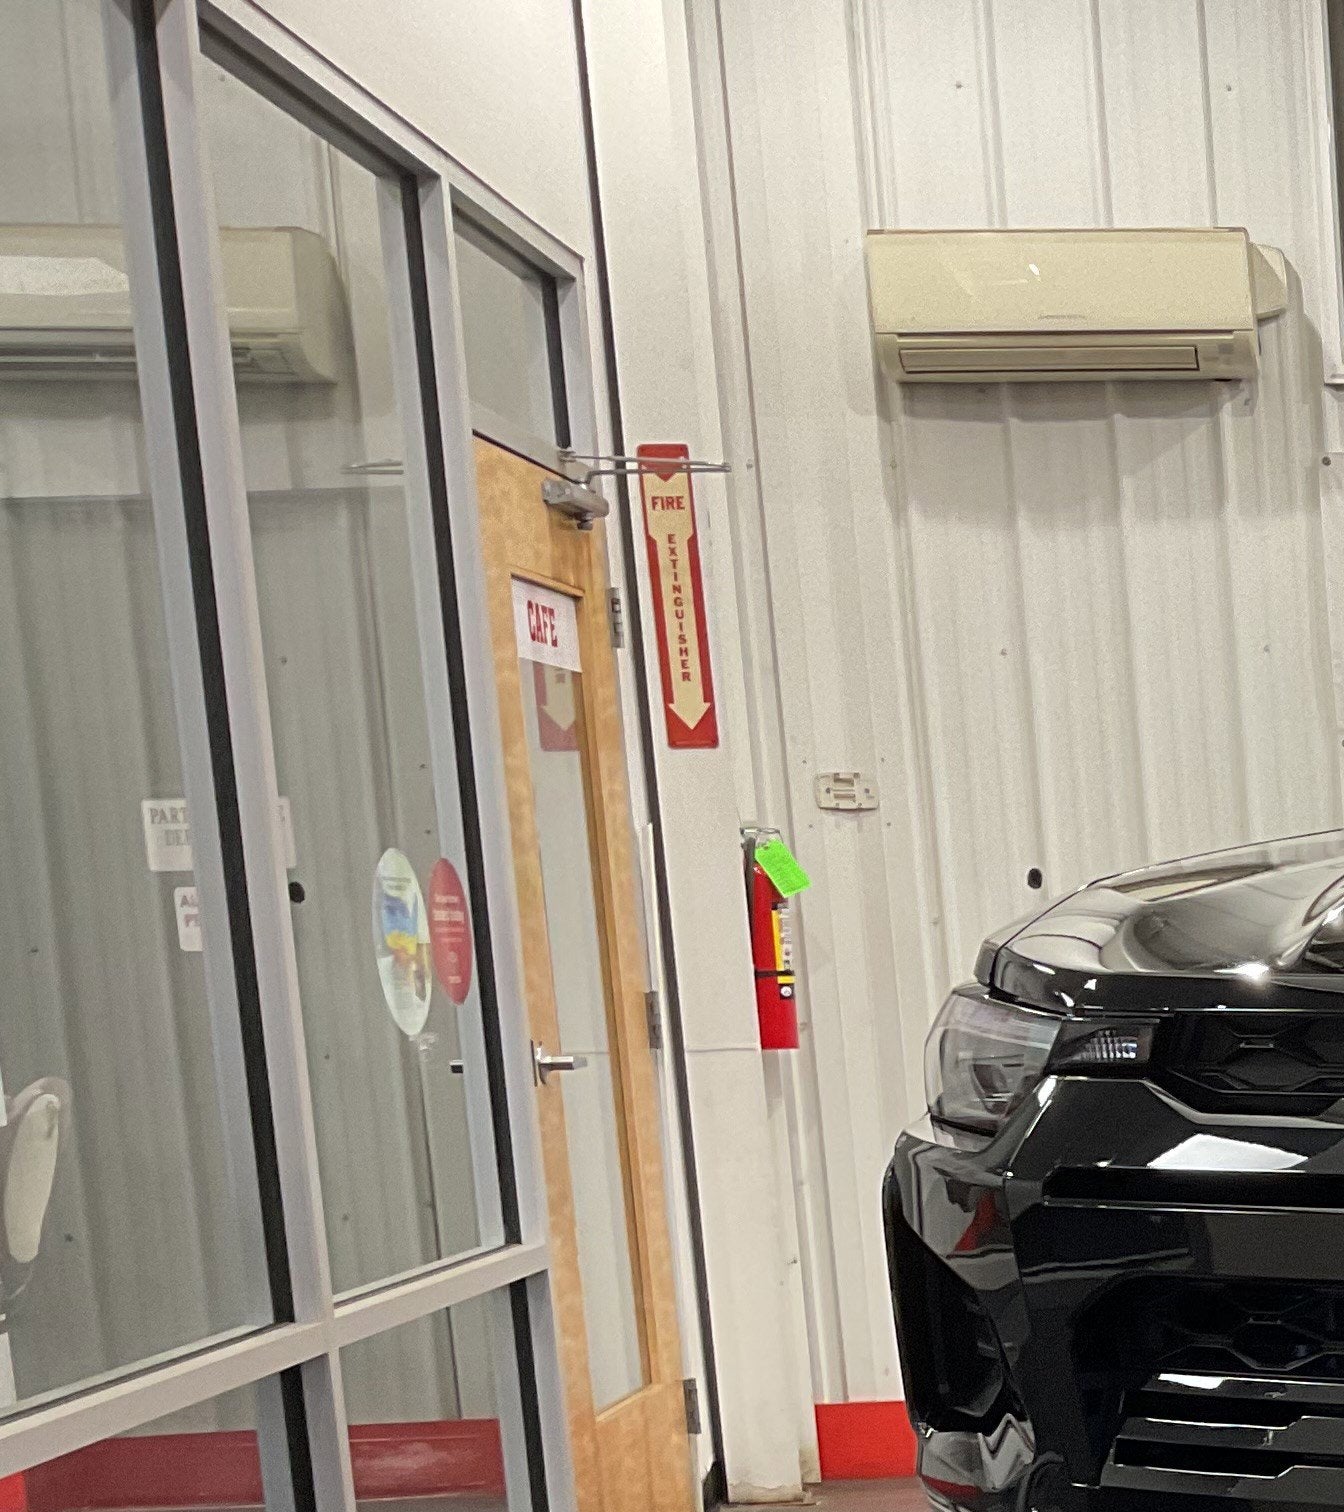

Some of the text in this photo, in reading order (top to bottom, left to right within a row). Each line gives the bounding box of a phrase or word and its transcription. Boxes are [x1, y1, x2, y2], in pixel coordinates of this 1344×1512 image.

[651, 495, 686, 511] FIRE
[526, 599, 558, 648] CAFE
[667, 533, 692, 682] EXTINGUISHER
